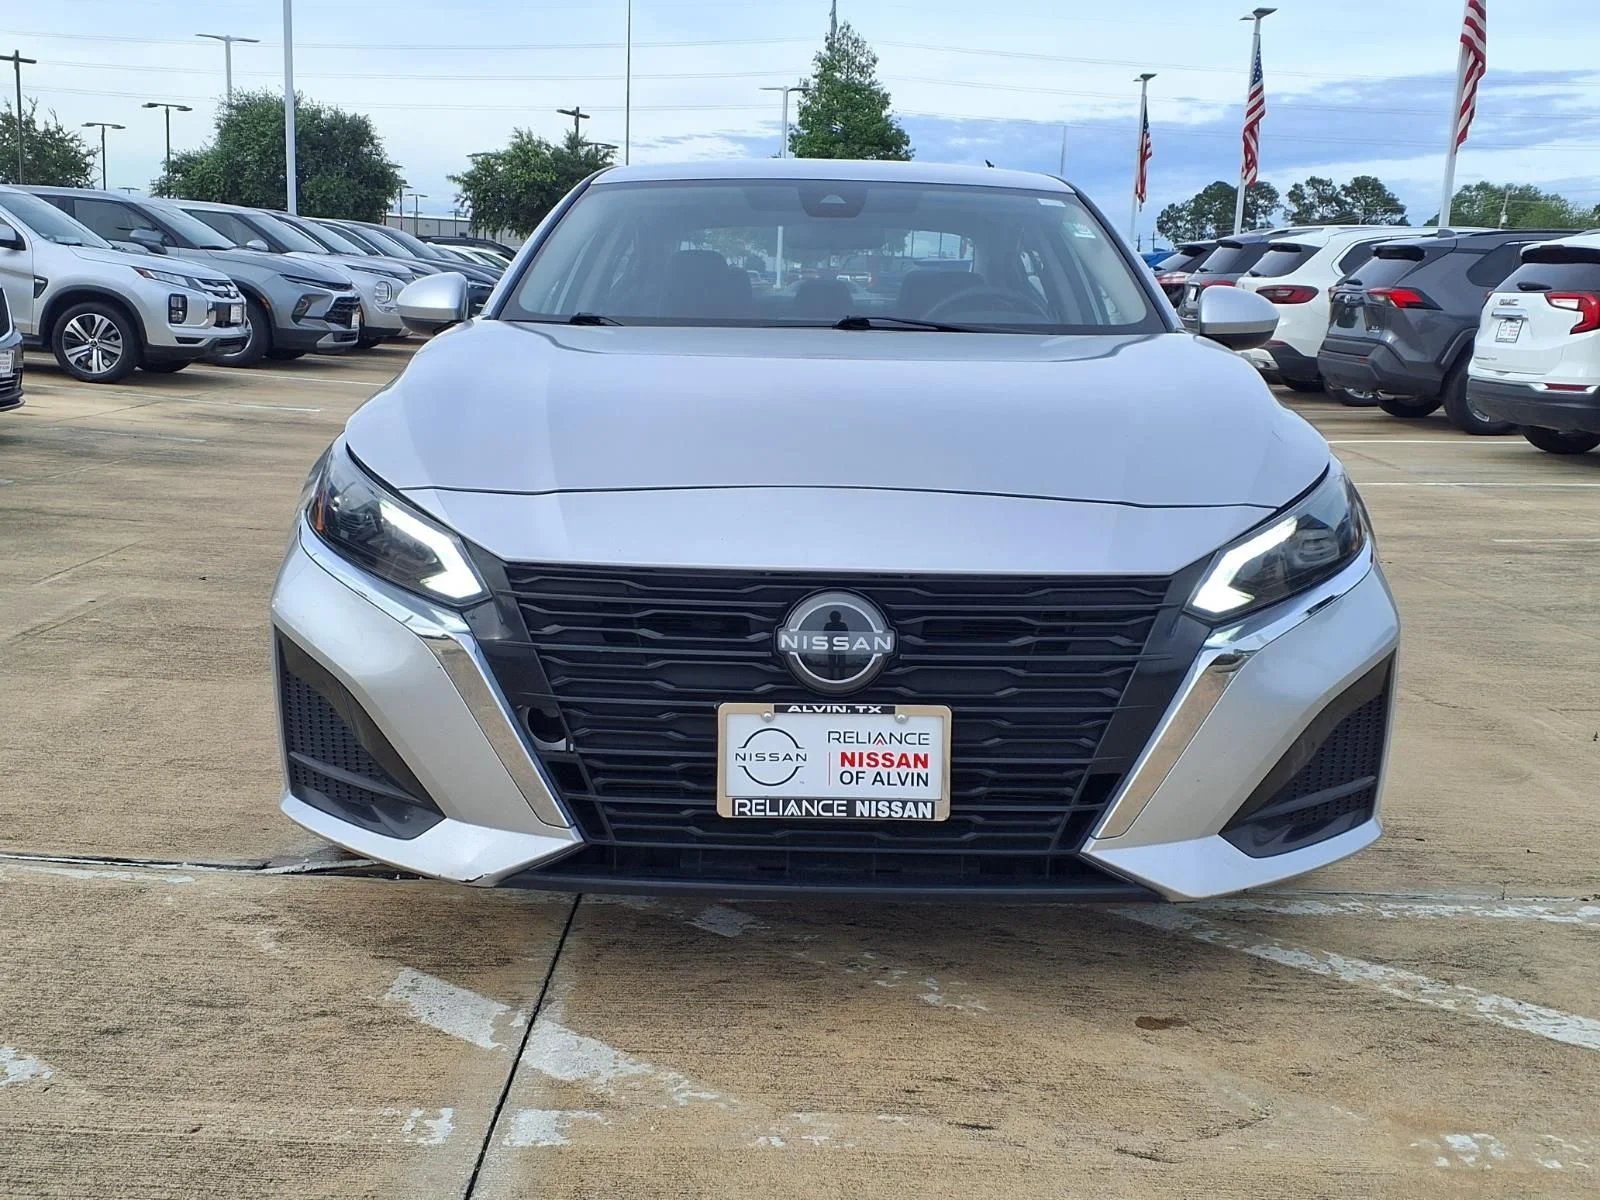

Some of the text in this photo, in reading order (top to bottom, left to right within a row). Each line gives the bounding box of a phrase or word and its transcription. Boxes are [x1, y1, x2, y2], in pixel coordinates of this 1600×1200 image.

[781, 634, 891, 651] NISSAN
[827, 730, 930, 746] RELIANCE
[735, 752, 807, 762] NISSAN
[840, 751, 929, 769] NISSAN
[840, 770, 929, 787] OF ALVIN
[735, 799, 933, 819] RELIANCE NISSAN
